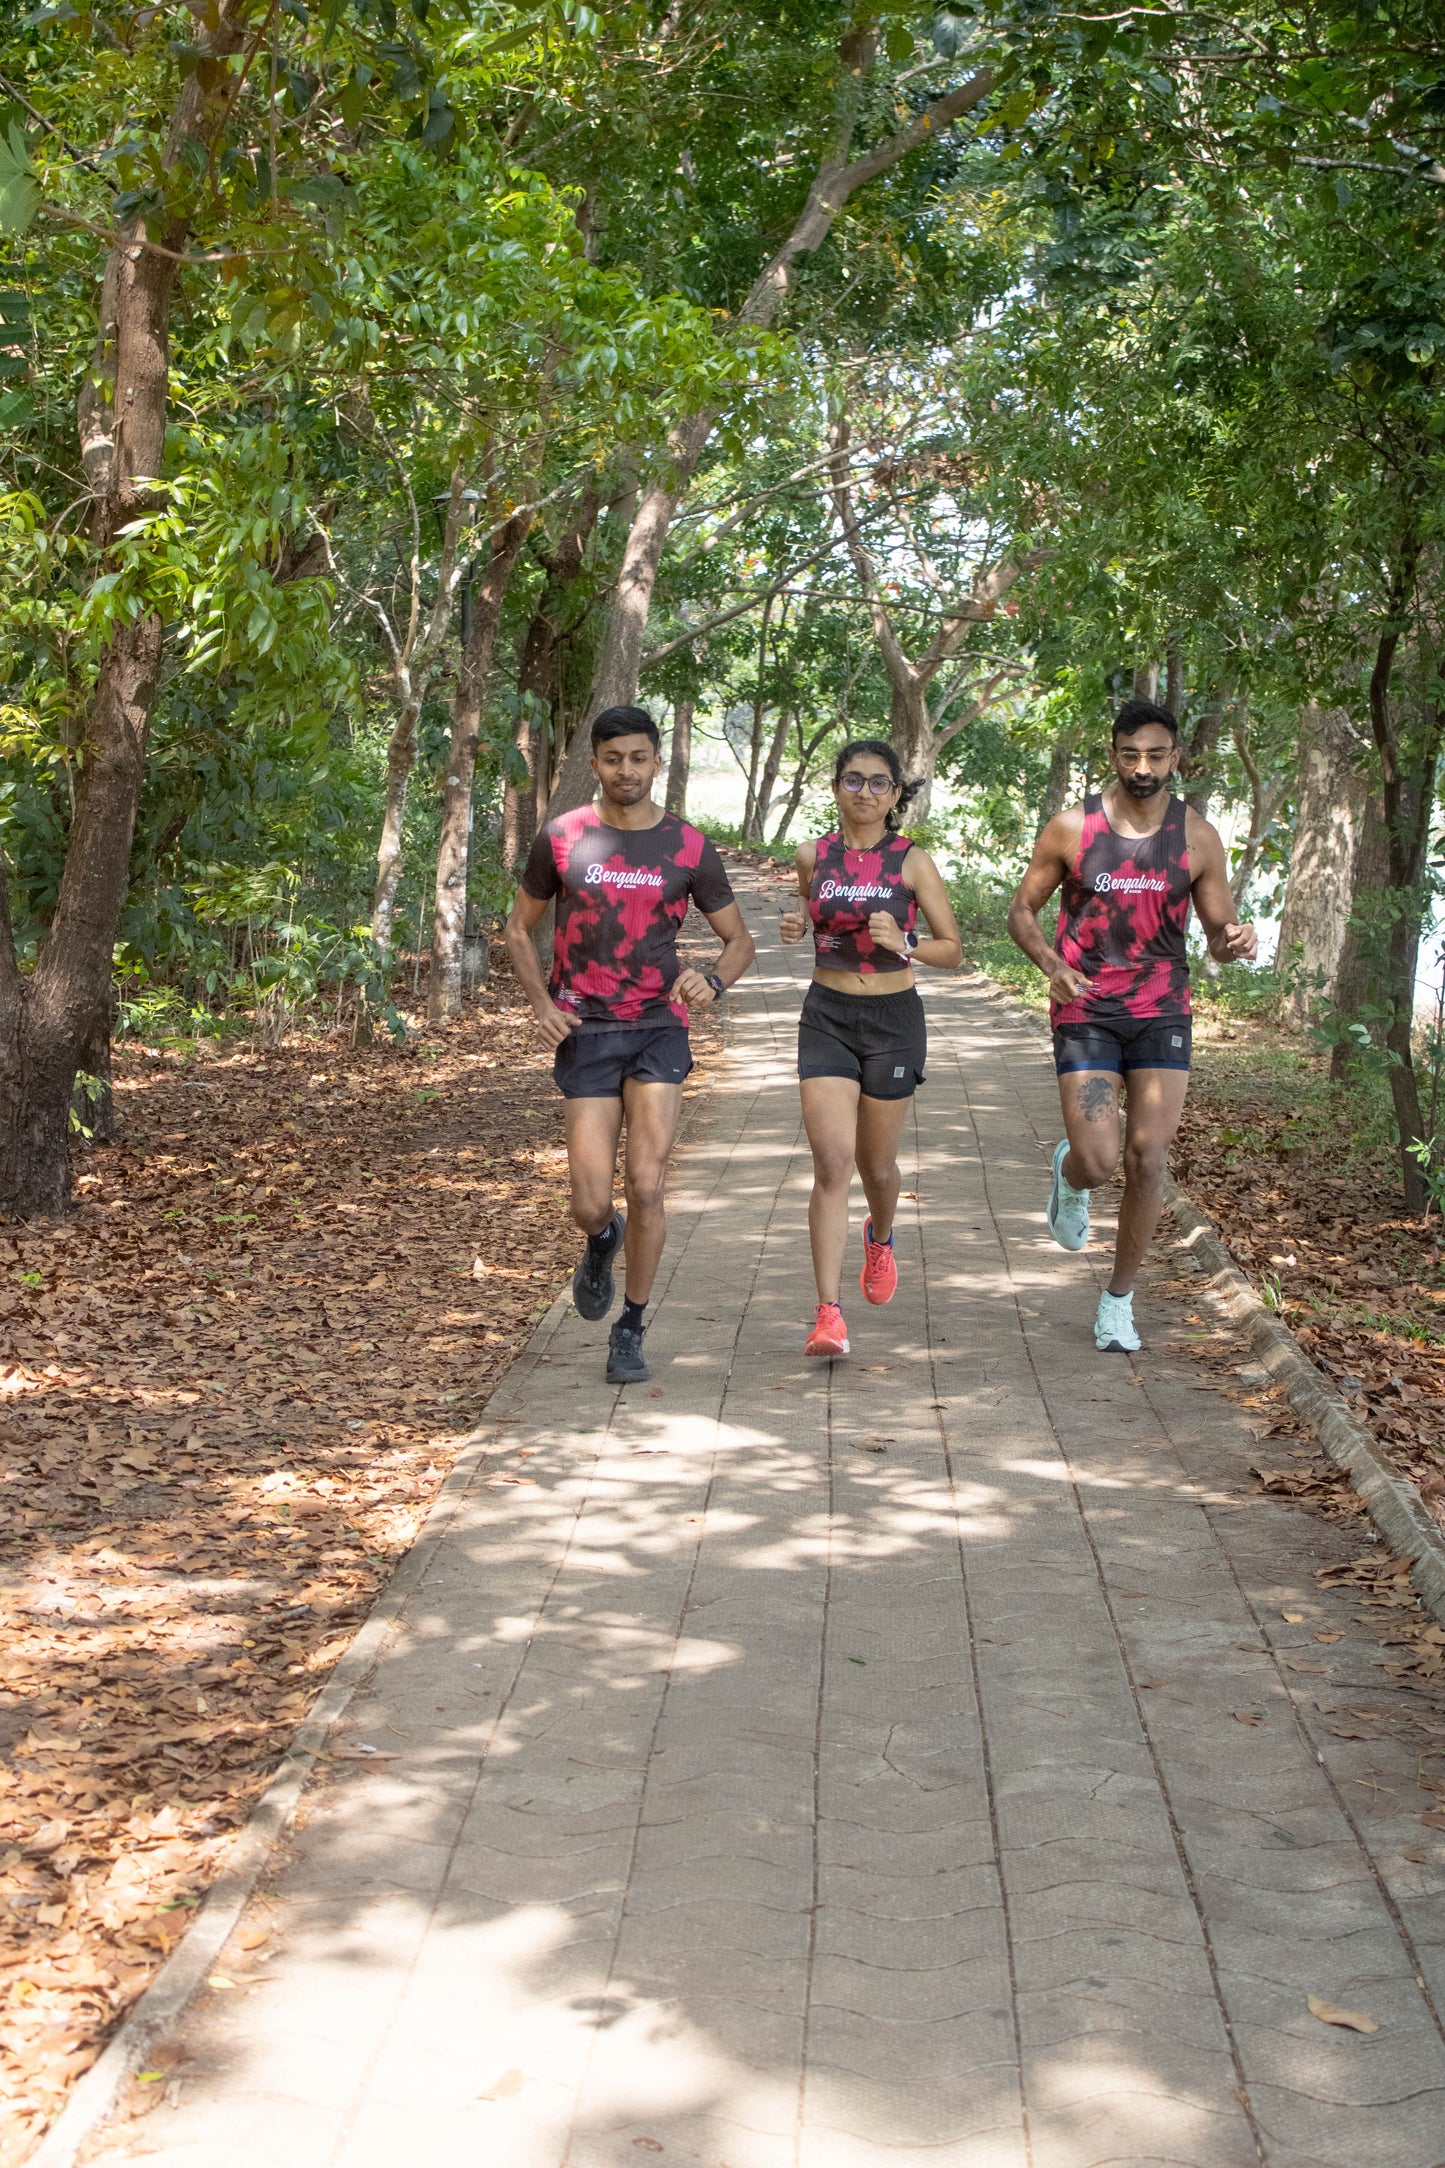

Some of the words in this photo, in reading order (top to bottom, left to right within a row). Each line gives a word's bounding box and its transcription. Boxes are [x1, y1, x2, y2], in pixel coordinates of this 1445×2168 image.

[584, 863, 664, 889] Bengaluru
[1094, 872, 1166, 895] Bengaluru
[819, 879, 894, 902] Bengaluru
